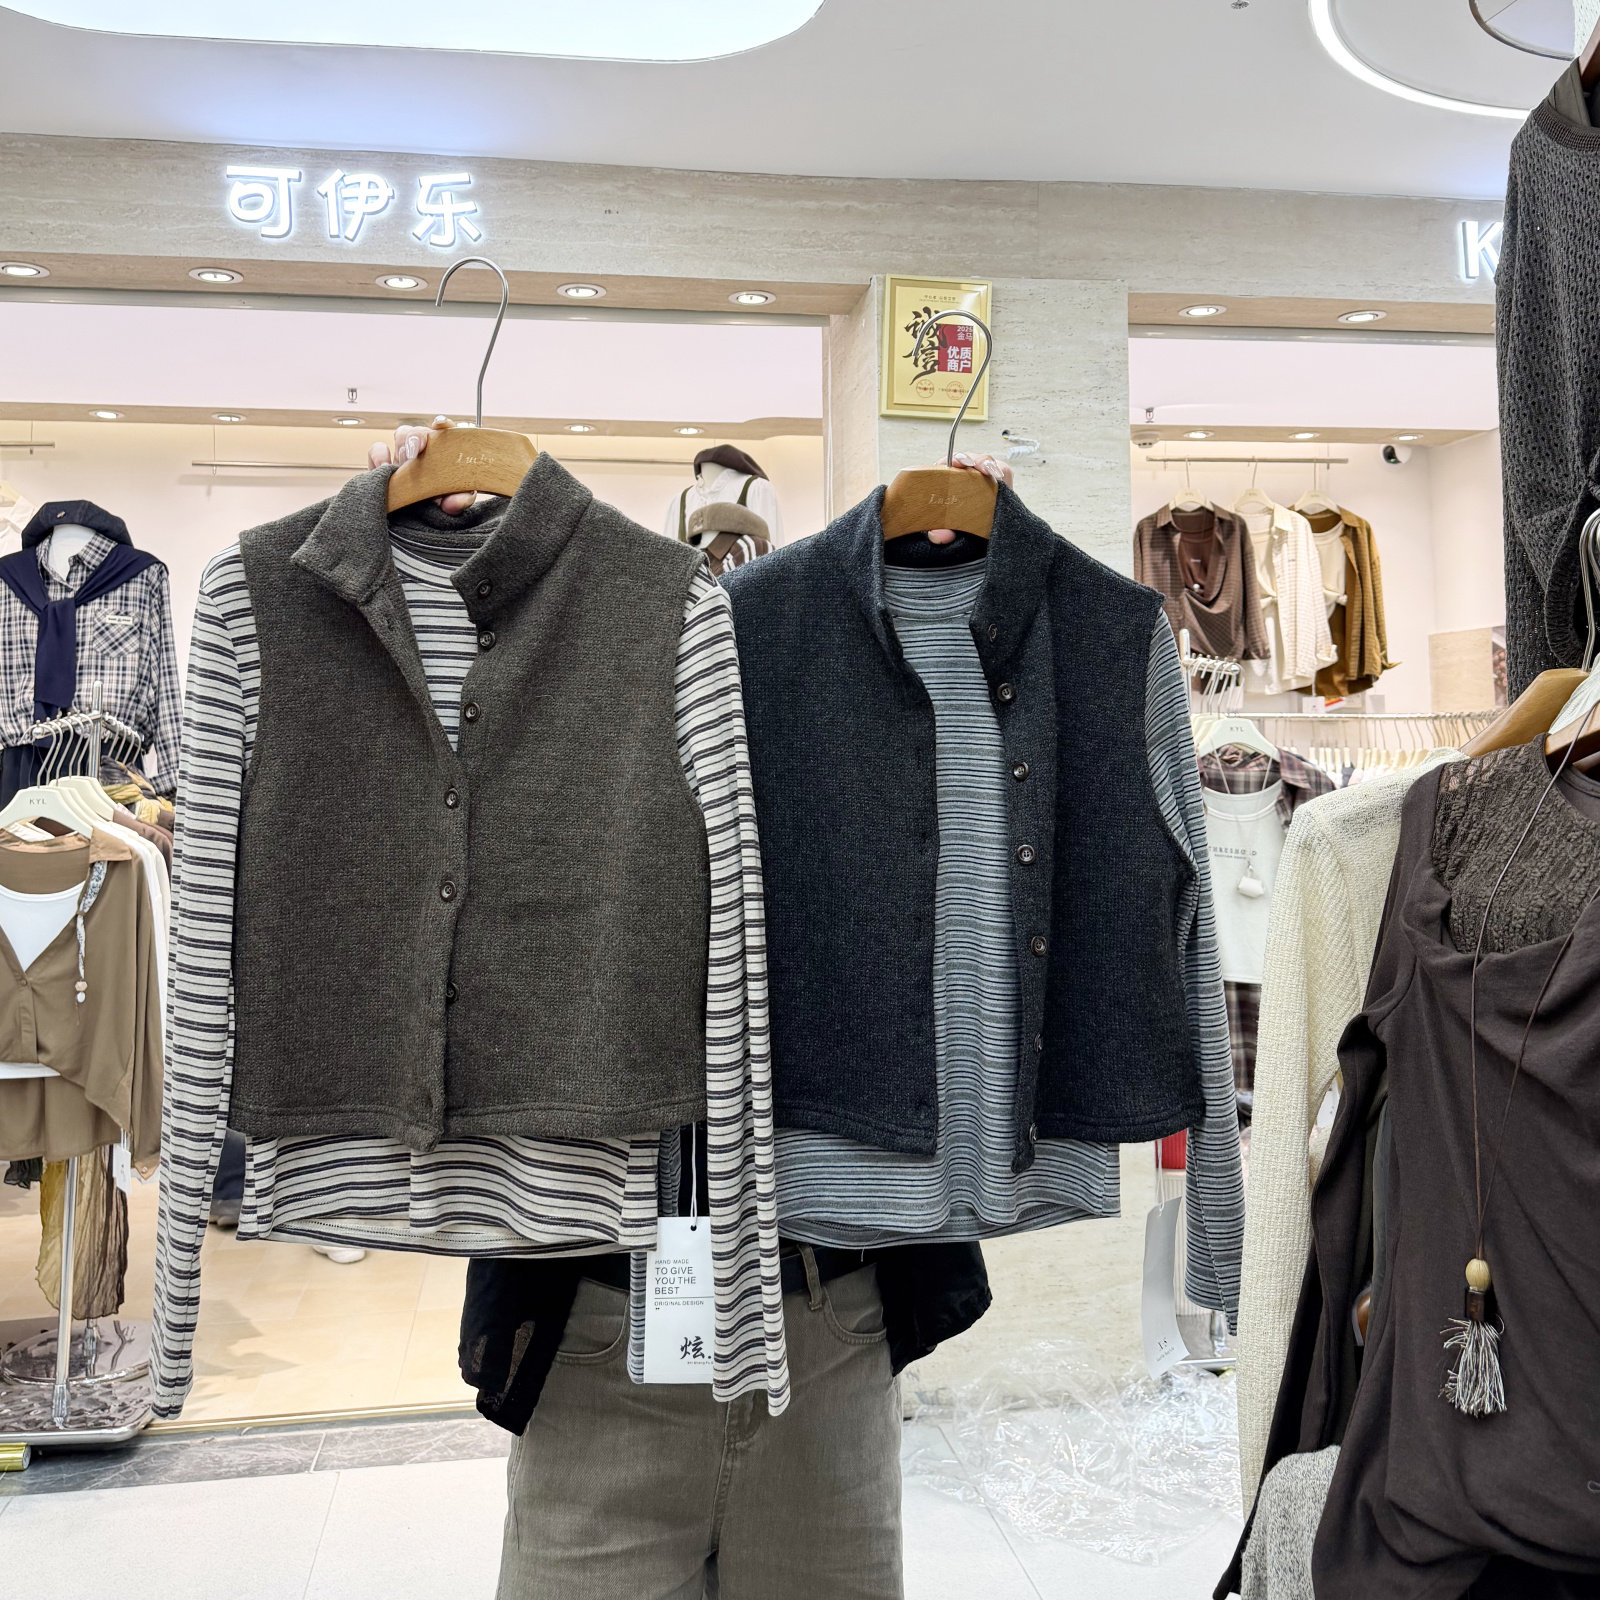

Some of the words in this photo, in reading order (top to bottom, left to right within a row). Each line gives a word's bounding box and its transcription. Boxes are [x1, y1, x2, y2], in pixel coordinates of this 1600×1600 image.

[226, 165, 482, 247] 可伊乐
[947, 345, 972, 360] 优质
[947, 359, 972, 372] 商户
[655, 1267, 668, 1275] TO
[670, 1266, 694, 1275] GIVE
[655, 1277, 676, 1285] YOU
[678, 1276, 697, 1285] THE
[654, 1286, 680, 1295] BEST
